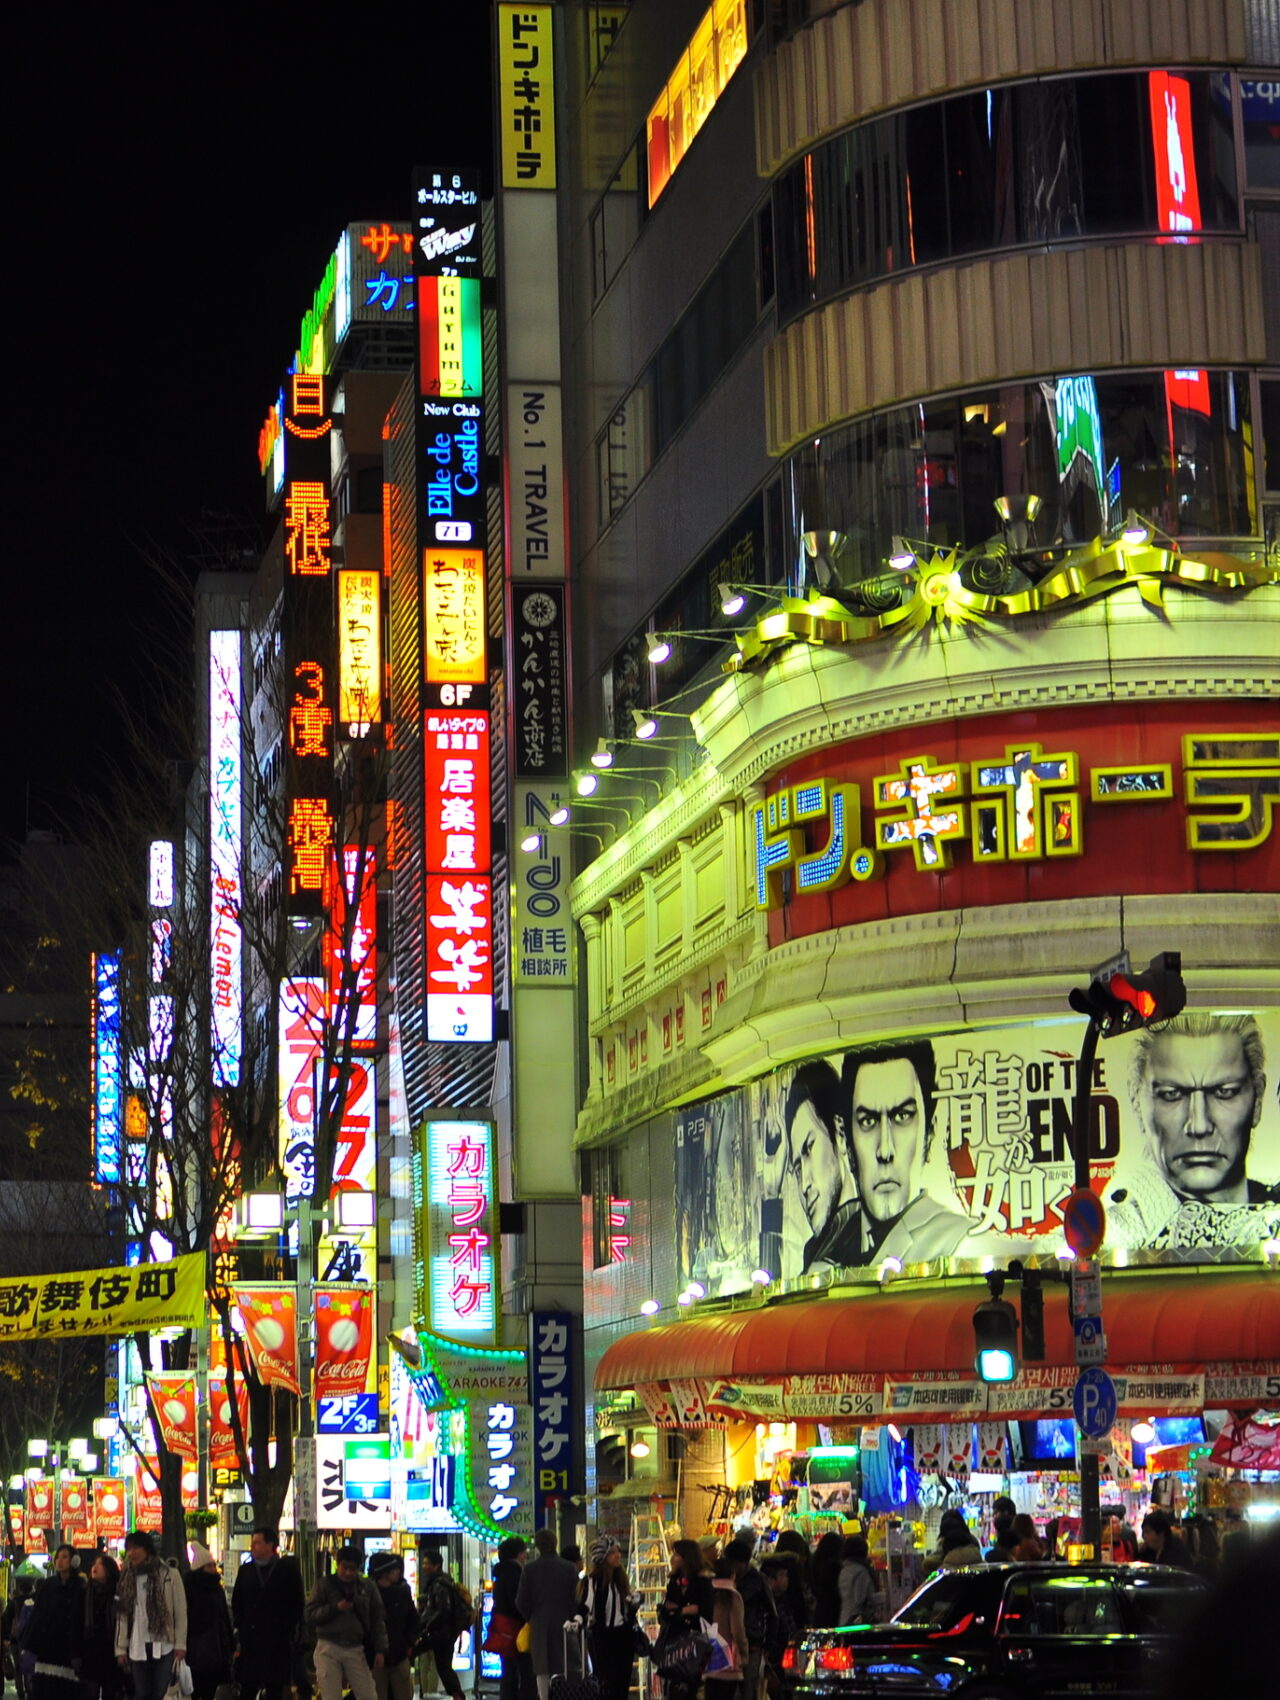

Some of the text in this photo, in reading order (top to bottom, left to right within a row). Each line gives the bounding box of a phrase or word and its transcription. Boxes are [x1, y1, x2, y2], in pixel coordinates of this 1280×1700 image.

[424, 403, 480, 417] New Club
[427, 420, 478, 517] Elle de Castle
[525, 465, 548, 570] TRAVEL
[440, 684, 472, 705] 6F
[440, 759, 476, 869] 居楽屋
[522, 927, 567, 954] 植毛
[521, 958, 567, 976] 相談所
[1026, 1062, 1054, 1093] OF
[330, 1061, 371, 1196] 27
[1026, 1093, 1121, 1165] END
[447, 1134, 491, 1318] カラオケ
[538, 1319, 570, 1463] カラオケ
[838, 1394, 874, 1414] 5%
[1083, 1384, 1100, 1427] P
[1095, 1407, 1108, 1427] 40
[487, 1401, 518, 1522] カラオケ
[538, 1469, 569, 1491] B1
